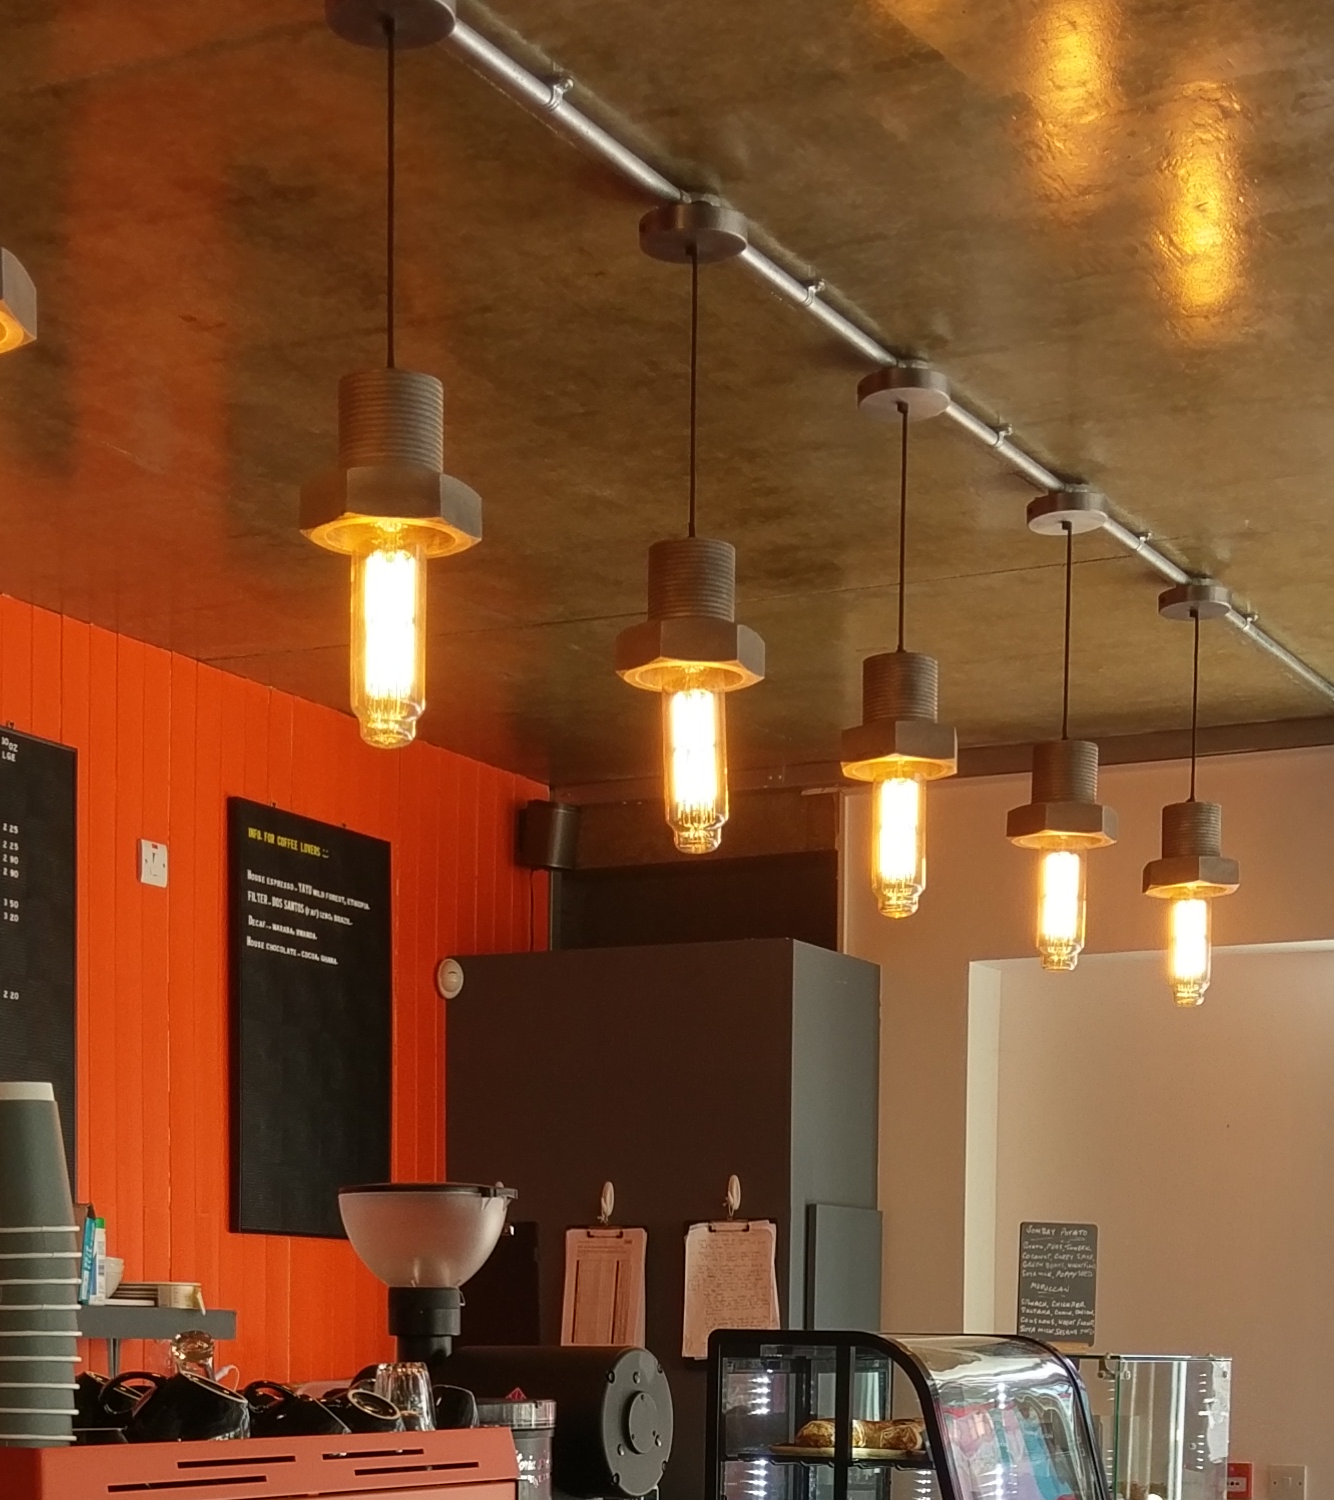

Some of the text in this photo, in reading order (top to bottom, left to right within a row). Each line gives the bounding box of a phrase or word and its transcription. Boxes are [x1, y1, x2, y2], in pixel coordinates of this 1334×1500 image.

[1, 750, 16, 762] LGE
[264, 831, 275, 844] FOR
[277, 835, 298, 851] COFFEE
[300, 842, 321, 857] LOVERS
[266, 877, 294, 891] ESPRESSO
[247, 890, 268, 906] FILTER
[272, 896, 283, 909] DOS
[284, 899, 305, 914] SANTOS
[266, 942, 297, 957] CHOCOLATE
